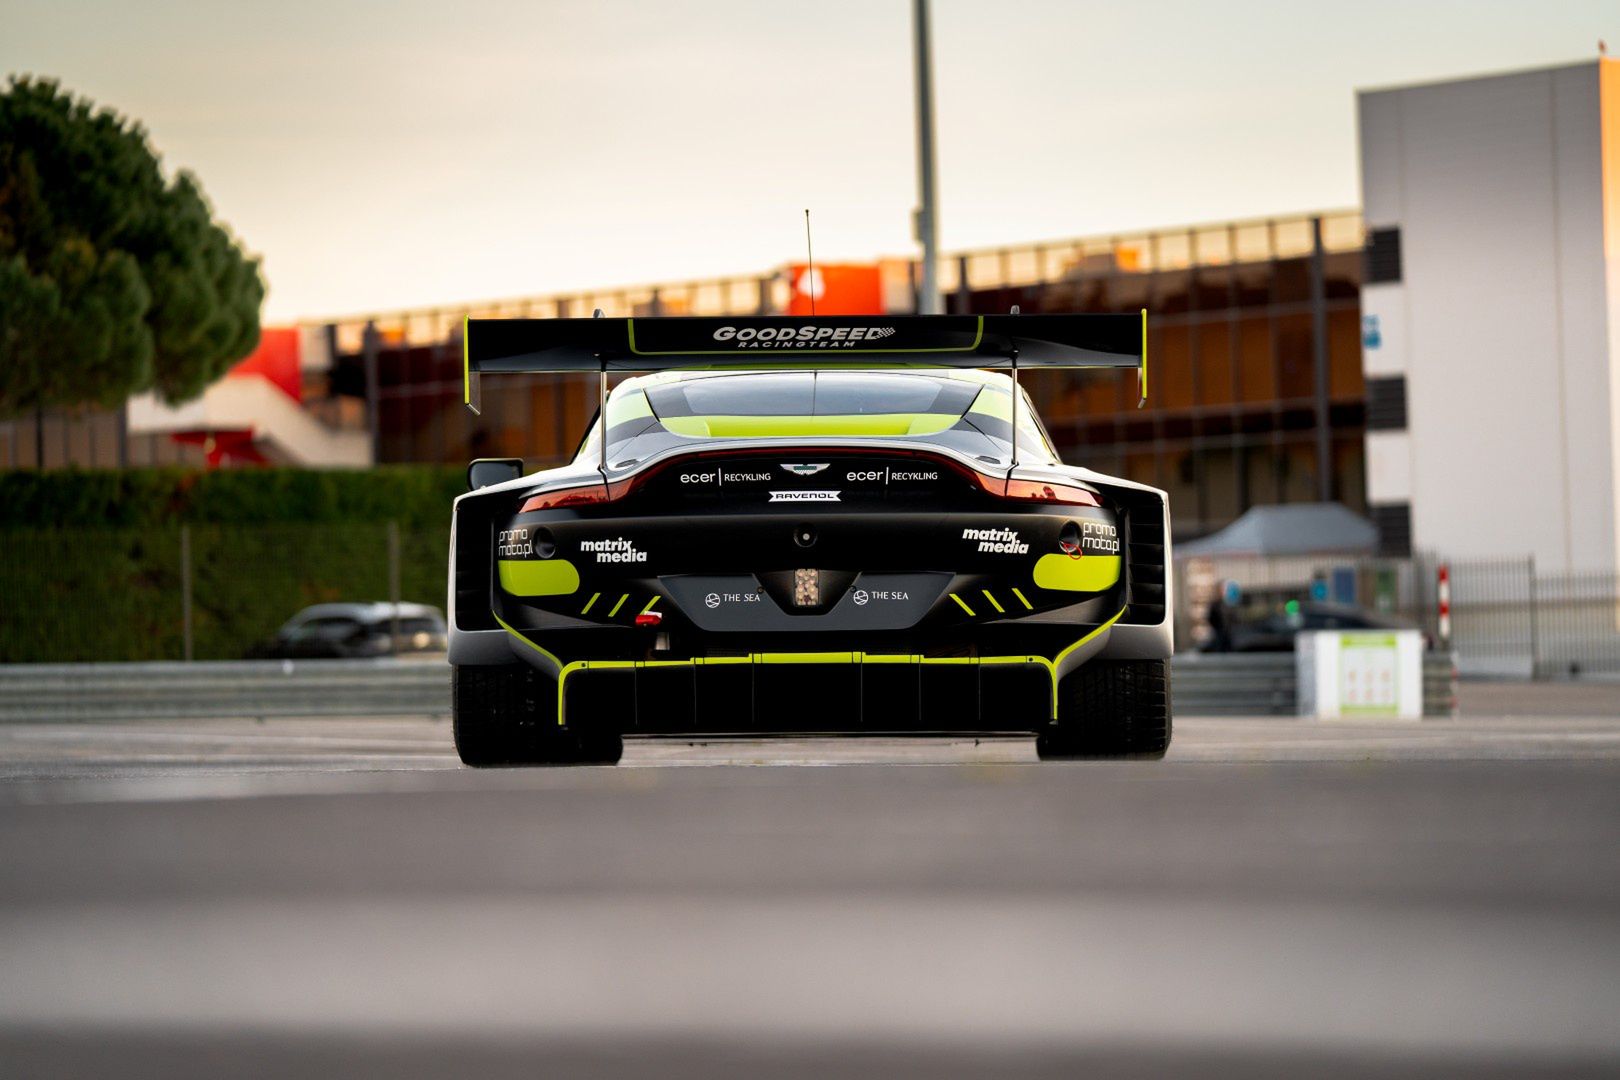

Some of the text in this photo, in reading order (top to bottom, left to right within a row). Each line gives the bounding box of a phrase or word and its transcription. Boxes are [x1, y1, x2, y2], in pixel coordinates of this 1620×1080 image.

[713, 326, 891, 341] GOODSPEED
[680, 472, 771, 484] ecer RECYKLING
[846, 470, 938, 482] ecer RECYKLING
[499, 528, 528, 545] promo
[961, 527, 1018, 542] matrix
[1083, 522, 1117, 537] promo
[498, 540, 533, 558] moto.pl
[580, 537, 632, 552] matrix
[978, 538, 1029, 554] media
[1082, 536, 1120, 554] moto.pl
[596, 549, 648, 563] media
[723, 593, 761, 602] THE SEA
[871, 591, 909, 600] THE SEA
